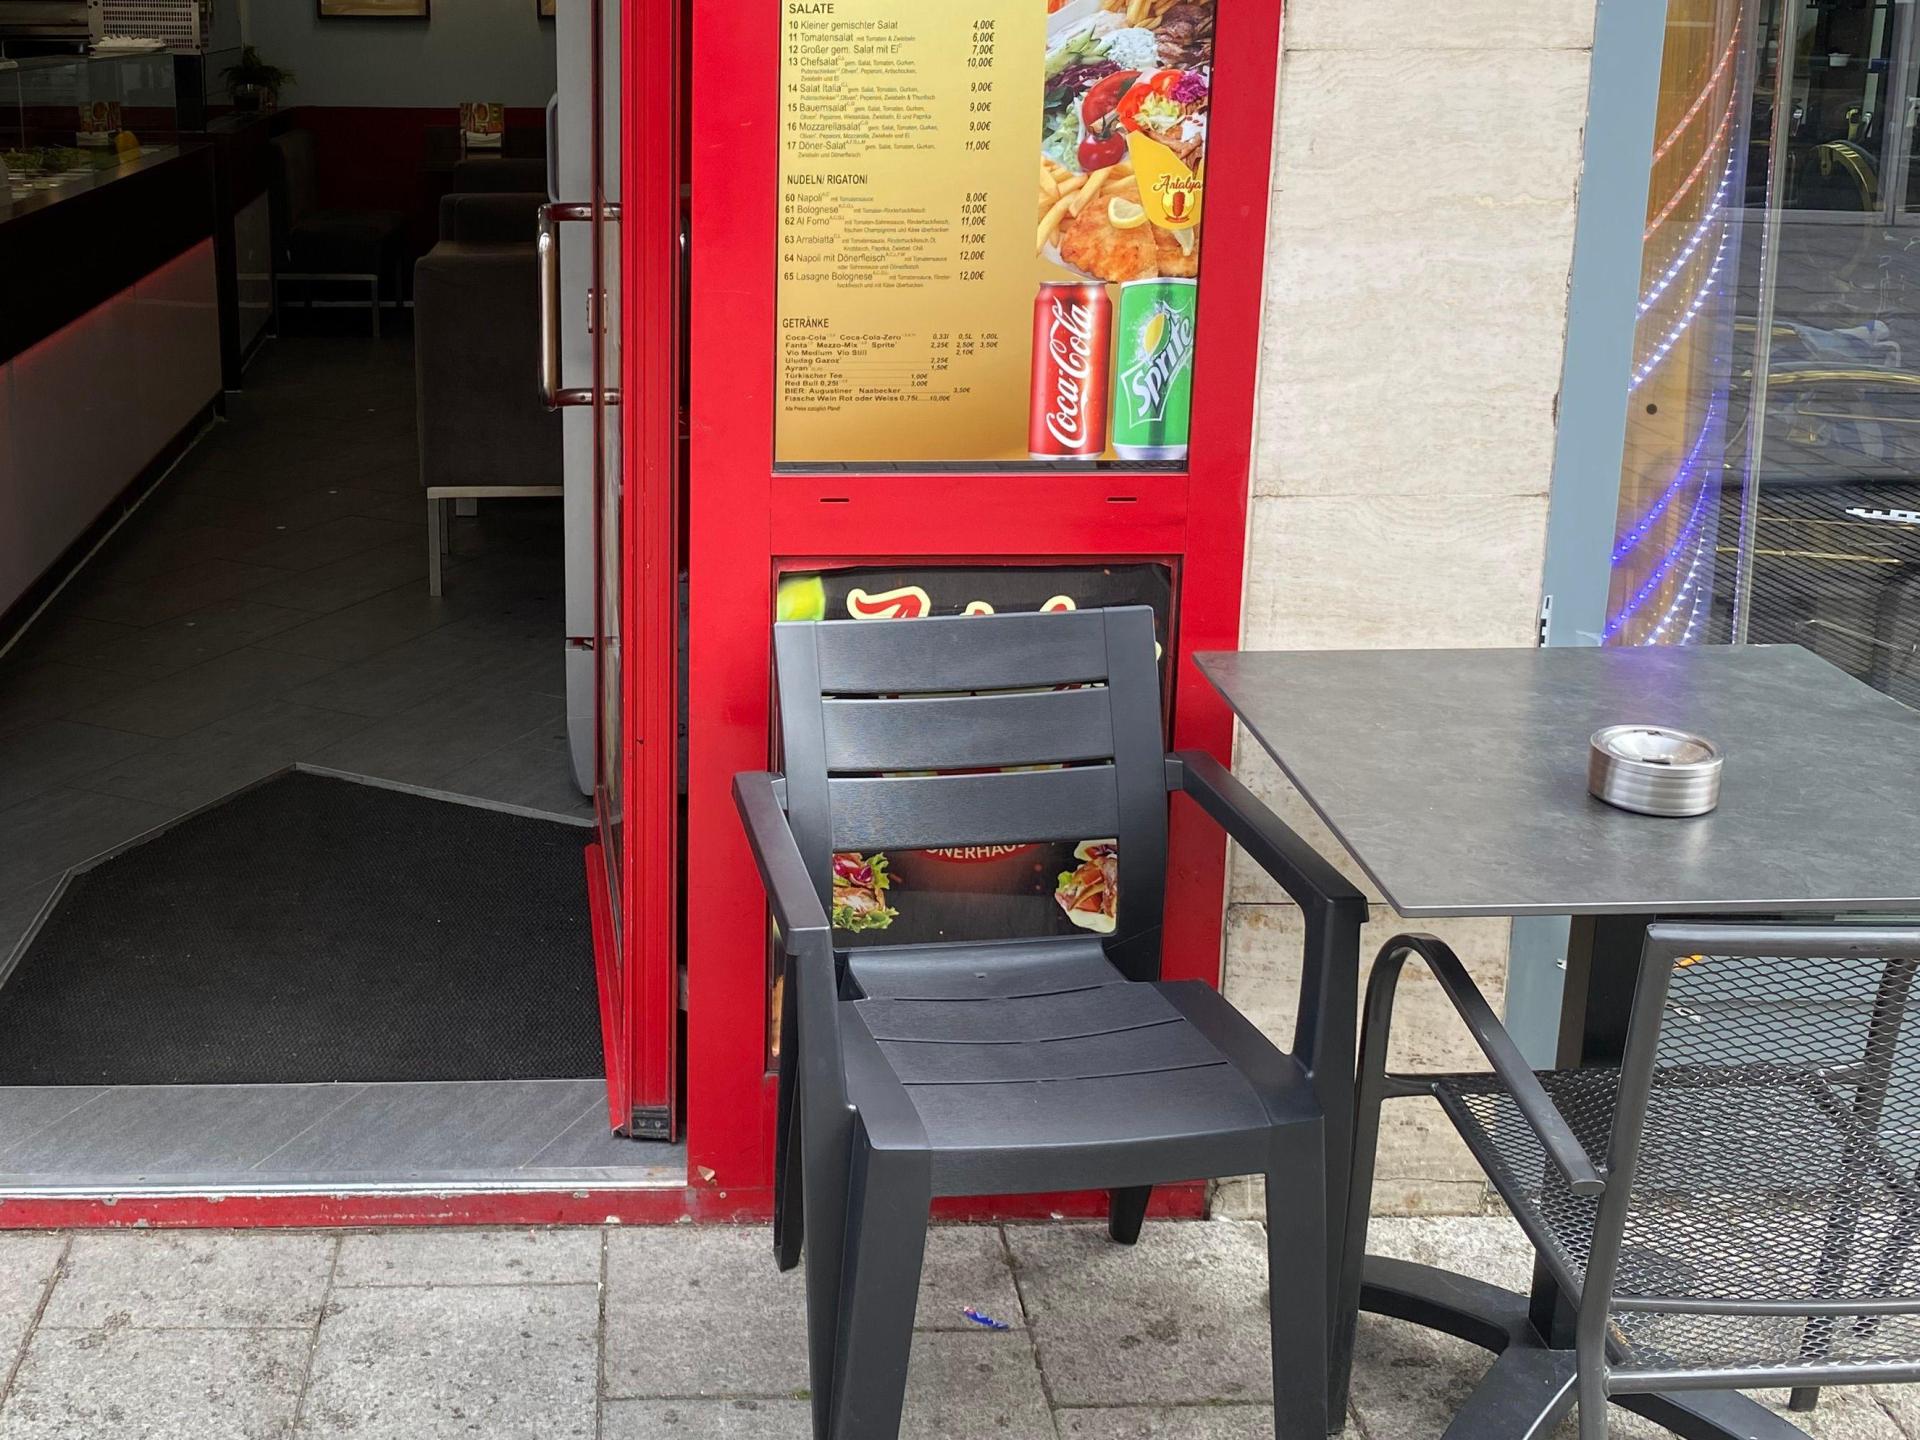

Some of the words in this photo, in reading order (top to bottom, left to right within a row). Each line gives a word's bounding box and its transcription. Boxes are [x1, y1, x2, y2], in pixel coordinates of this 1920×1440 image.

[789, 3, 834, 14] SALATE
[789, 21, 799, 29] 10
[801, 20, 830, 29] Kleiner
[831, 20, 876, 31] gemischter
[877, 20, 898, 29] Salat
[973, 20, 995, 31] 4,00€
[789, 33, 798, 41] 11
[801, 33, 854, 41] Tomatensalat
[973, 32, 995, 43] 6,00€
[789, 45, 798, 53] 12
[801, 45, 829, 53] Großer
[854, 45, 874, 53] Salat
[876, 45, 888, 53] mit
[973, 45, 995, 56] 7,00€
[789, 57, 798, 65] 13
[967, 57, 994, 68] 10,00€
[788, 84, 797, 92] 14
[800, 84, 820, 92] Salat
[971, 82, 992, 93] 9,00€
[788, 103, 797, 111] 15
[970, 102, 991, 112] 9,00€
[787, 122, 797, 130] 16
[969, 121, 991, 132] 9,00€
[787, 141, 796, 149] 17
[965, 140, 990, 151] 11,00€
[827, 175, 868, 185] RIGATONI
[1153, 175, 1202, 194] Antalya
[785, 194, 795, 202] 60
[965, 193, 988, 203] 8,00€
[785, 205, 794, 213] 61
[961, 205, 987, 215] 10,00€
[785, 217, 794, 225] 62
[797, 217, 804, 225] Al
[961, 216, 986, 226] 11,00€
[784, 235, 794, 244] 63
[961, 234, 986, 244] 11,00€
[784, 254, 794, 262] 64
[797, 254, 821, 264] Napoli
[823, 254, 835, 262] mit
[959, 251, 985, 261] 12,00€
[783, 272, 793, 280] 65
[796, 272, 830, 282] Lasagne
[959, 271, 985, 281] 12,00€
[783, 316, 829, 328] GETRÄNKE
[1132, 316, 1192, 417] Sprite
[926, 844, 1026, 859] NERHAU
